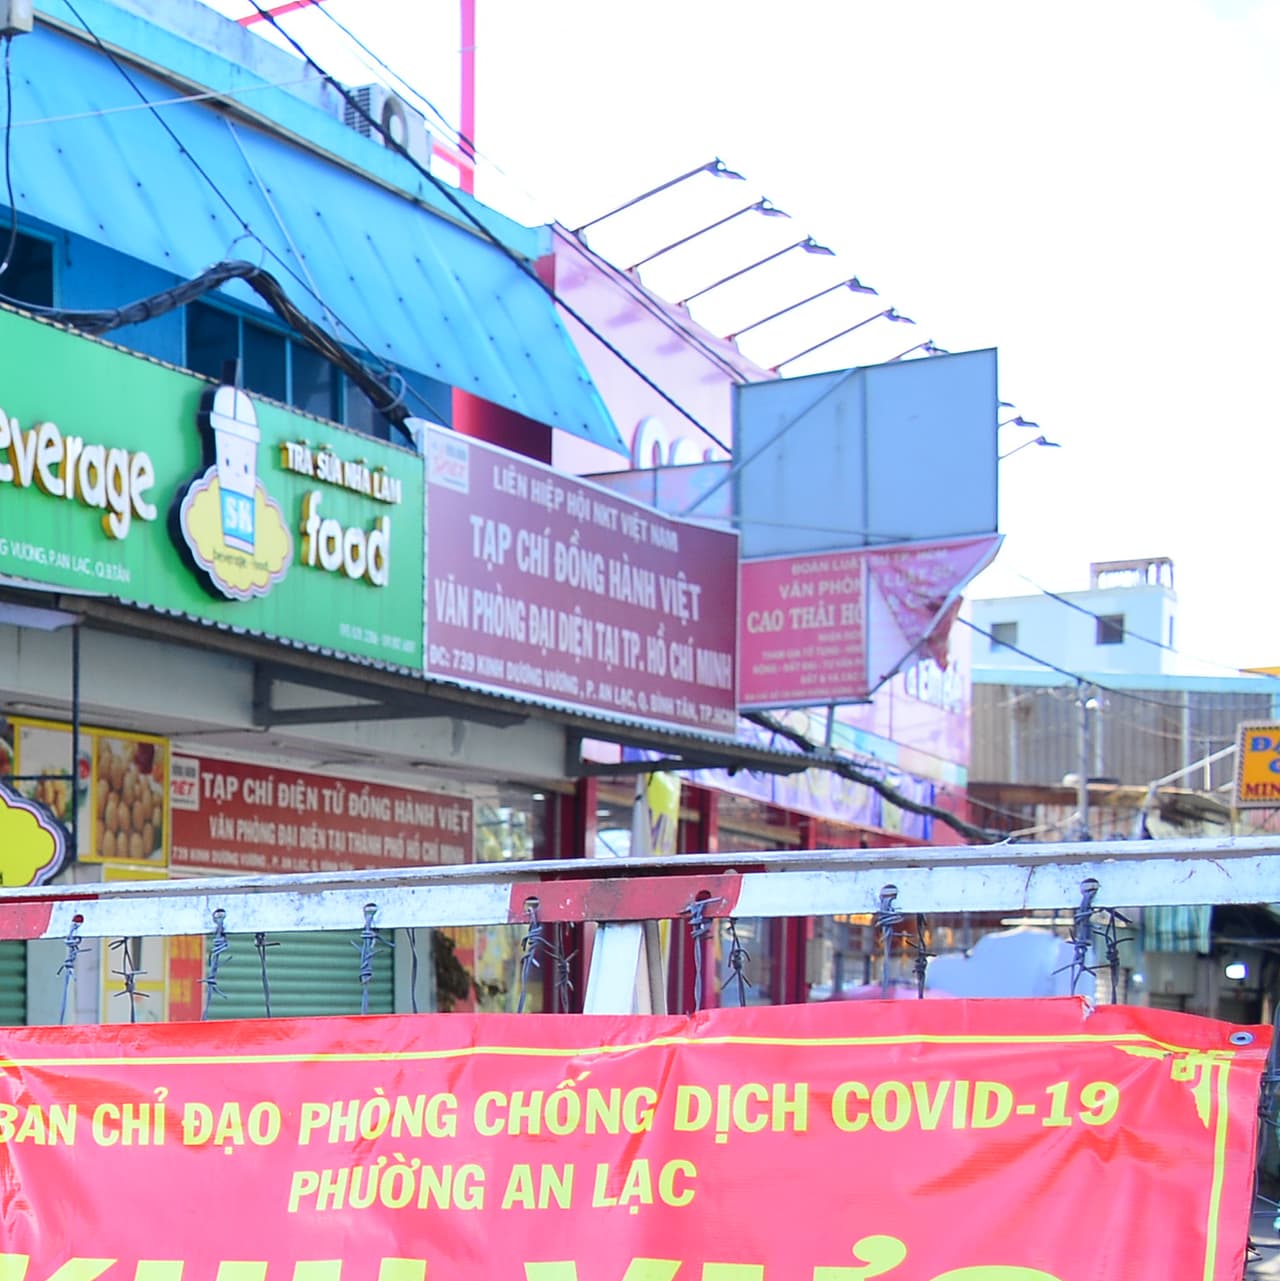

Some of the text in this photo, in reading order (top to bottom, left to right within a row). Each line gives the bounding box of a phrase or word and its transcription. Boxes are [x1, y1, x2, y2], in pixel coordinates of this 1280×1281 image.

[280, 439, 314, 475] TRÀ
[343, 457, 371, 494] NHÀ
[371, 465, 402, 504] LÀM
[300, 491, 390, 587] food
[493, 464, 527, 499] LIÊN
[530, 476, 564, 514] HIỆP
[567, 490, 590, 523] HỘI
[620, 511, 648, 543] VIỆT
[650, 524, 679, 552] NAM
[470, 514, 702, 625] TẠP CHÍ ĐỒNG HÀNH VIỆT
[779, 582, 814, 600] VĂN
[434, 575, 469, 628] VĂN
[472, 583, 527, 643] PHÒNG
[529, 604, 556, 656] ĐẠI
[558, 606, 593, 663] DIỆN
[595, 622, 620, 671] TẠI
[622, 628, 645, 672] TP.
[669, 636, 695, 683] CHÍ
[696, 648, 733, 690] MINH
[747, 610, 785, 633] CAO
[790, 601, 836, 629] THÁI
[452, 649, 476, 672] 739
[476, 656, 505, 680] KINH
[202, 772, 239, 804] TẠP
[243, 774, 274, 806] CHÍ
[278, 779, 318, 815] ĐIỆN
[394, 796, 435, 827] HÀNH
[438, 803, 470, 834] VIỆT
[209, 813, 234, 840] VĂN
[236, 815, 276, 846] PHÒNG
[92, 1086, 167, 1147] CHỈ
[183, 1102, 281, 1155] ĐẠO
[299, 1087, 458, 1146] PHÒNG
[474, 1072, 657, 1137] CHỐNG
[674, 1081, 809, 1144] DỊCH
[831, 1080, 1120, 1133] COVID-19
[288, 1156, 697, 1215] PHƯỜNG AN LẠC
